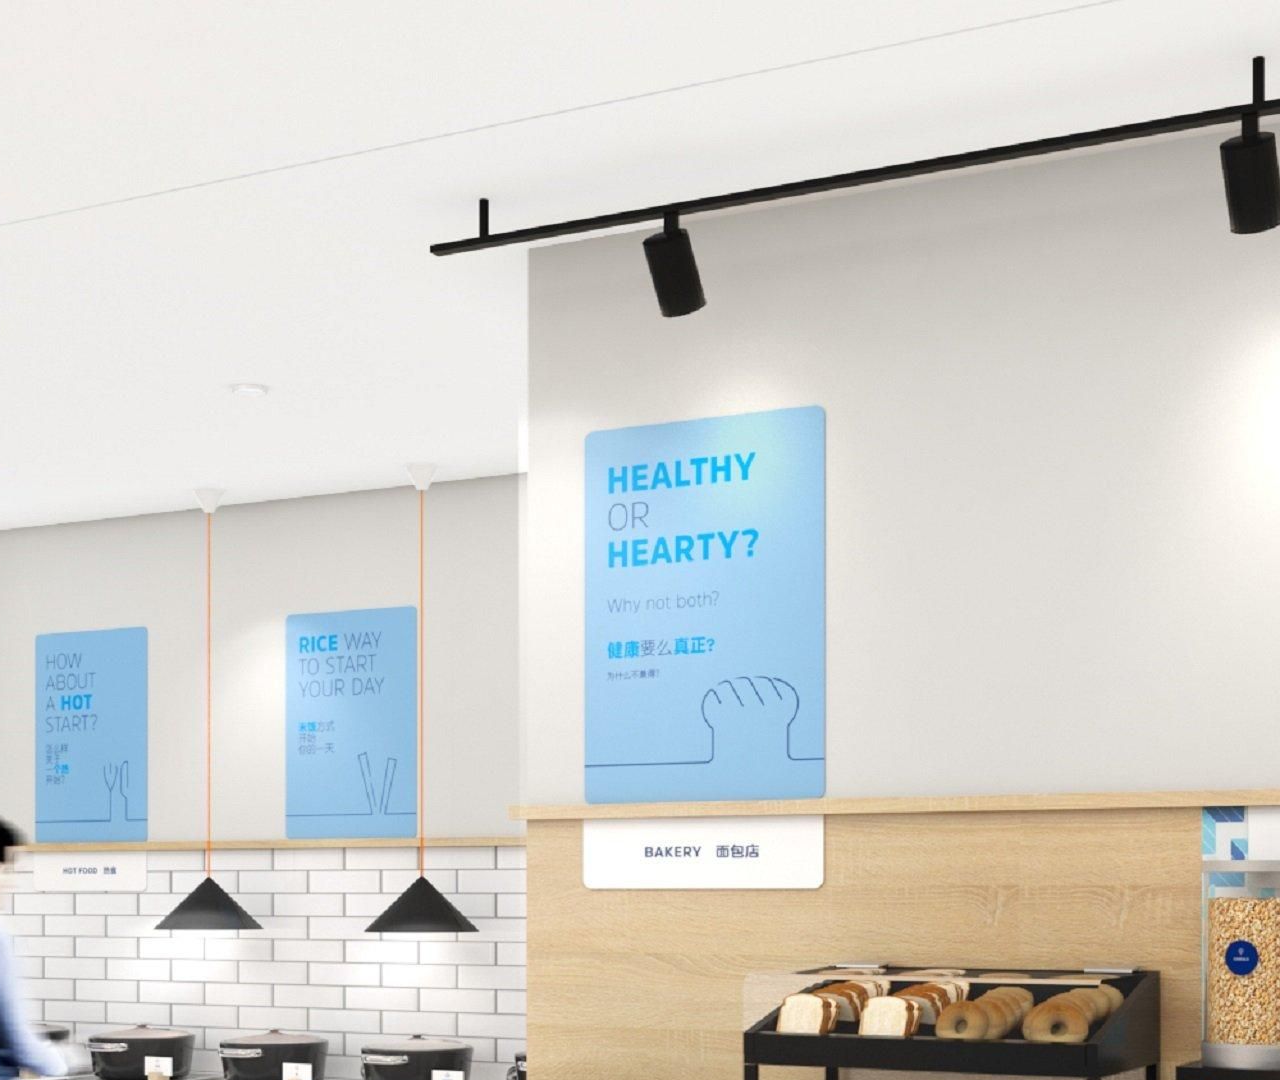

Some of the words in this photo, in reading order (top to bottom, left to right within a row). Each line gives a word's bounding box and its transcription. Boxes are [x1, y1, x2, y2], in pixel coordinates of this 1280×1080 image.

[607, 451, 757, 495] HEALTHY
[607, 501, 650, 532] OR
[607, 528, 760, 569] HEARTY?
[607, 598, 641, 614] Why
[645, 597, 672, 611] not
[676, 590, 720, 609] both?
[299, 634, 338, 653] RICE
[343, 631, 382, 651] WAY
[45, 652, 82, 671] HOW
[299, 657, 320, 676] TO
[325, 653, 377, 675] START
[45, 672, 97, 692] ABOUT
[298, 678, 345, 699] YOUR
[352, 676, 385, 696] DAY
[45, 695, 56, 712] A
[60, 693, 93, 711] HOT
[45, 713, 98, 734] START?
[644, 846, 702, 858] BAKERY
[716, 844, 760, 859] 面包店
[78, 867, 98, 875] FOOD
